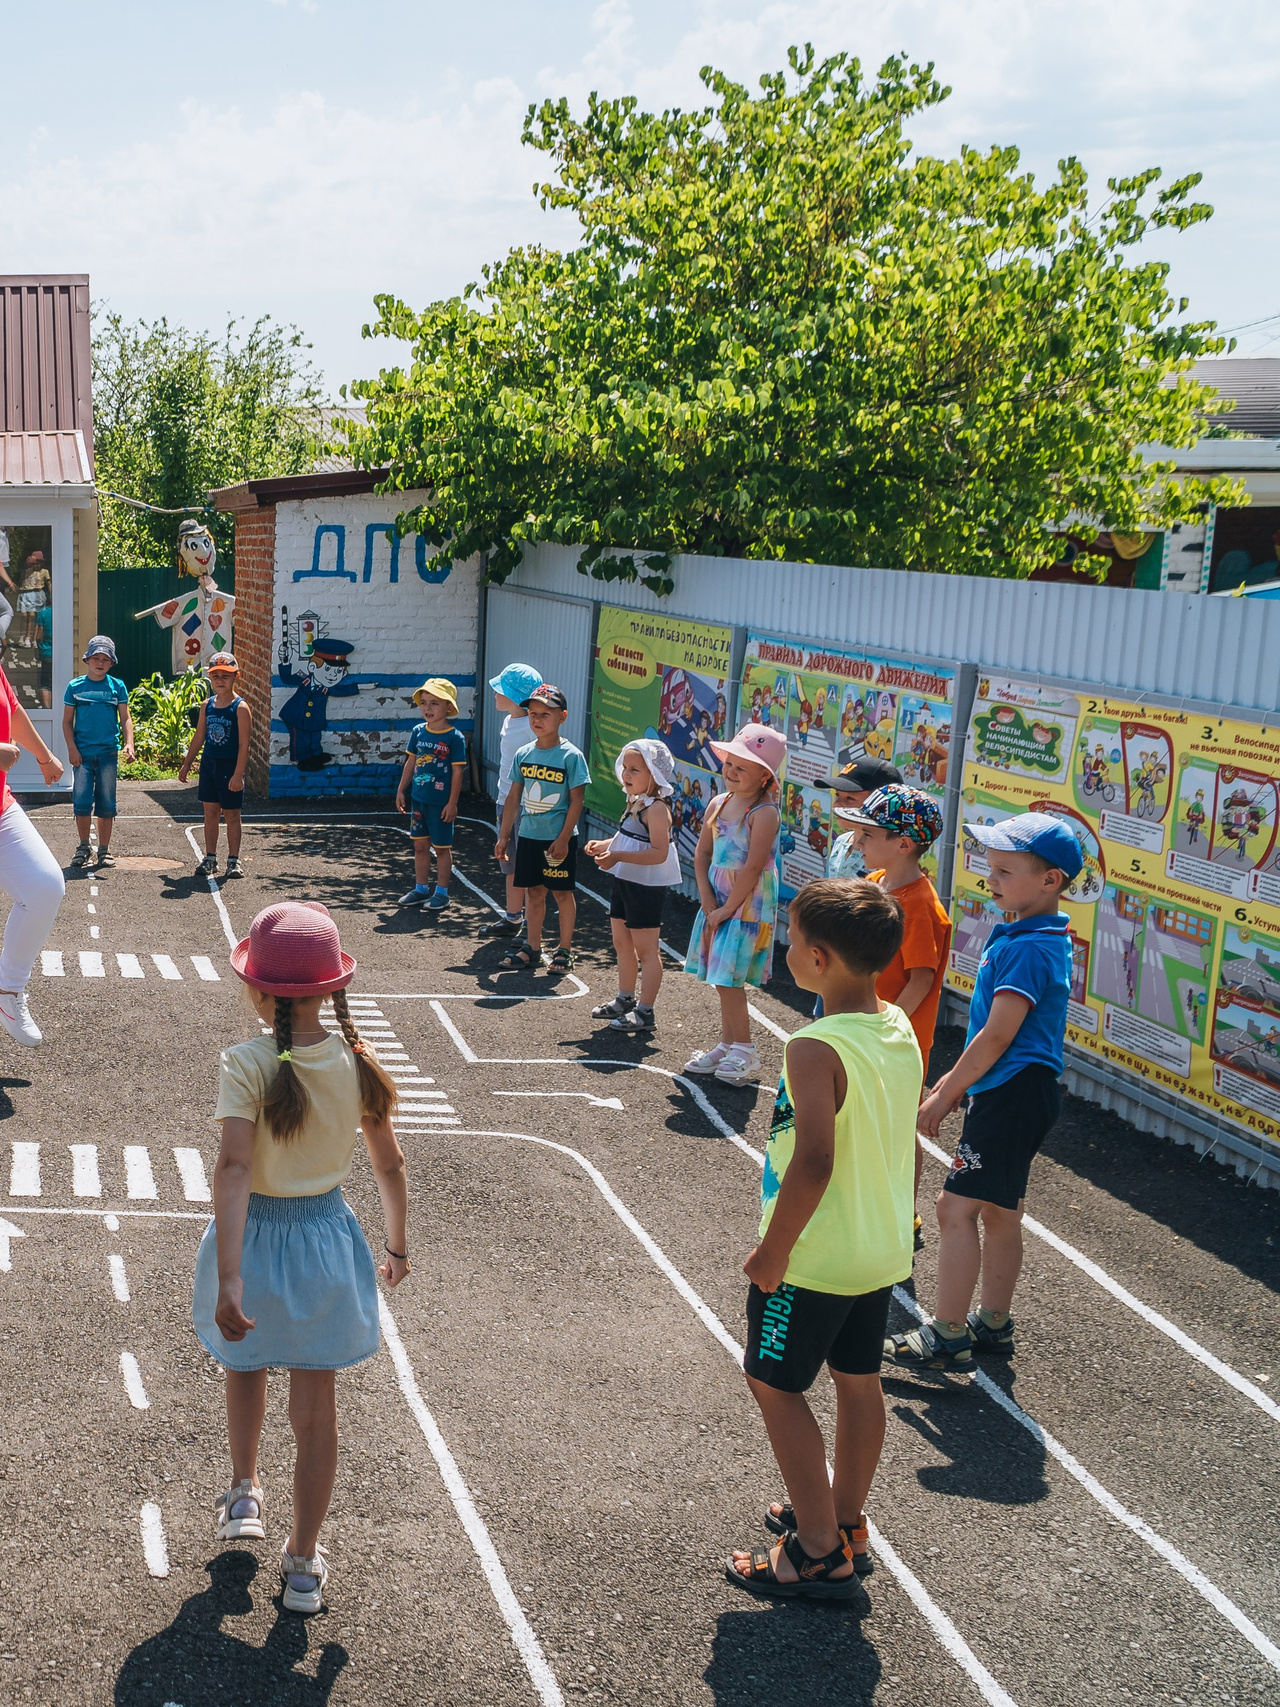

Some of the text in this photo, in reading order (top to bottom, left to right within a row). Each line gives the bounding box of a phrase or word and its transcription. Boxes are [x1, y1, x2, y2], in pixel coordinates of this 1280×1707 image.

[292, 522, 453, 584] ДПС
[684, 650, 729, 672] НА ДОРОГЕ
[757, 643, 948, 697] ПРАВИЛА ДОРОЖНОГО ДВИЖЕНИЯ
[1086, 700, 1102, 714] 2.
[1103, 706, 1120, 717] Твои
[1153, 713, 1162, 721] не
[986, 732, 1046, 752] НАЧИНАЮЩИМ
[1200, 726, 1219, 743] 3.
[984, 741, 1058, 764] ВЕЛОСИПЕДИСТАМ
[1189, 743, 1200, 751] не
[1237, 750, 1273, 763] повозка
[520, 764, 564, 783] adidas
[972, 773, 984, 787] 1.
[985, 780, 1008, 791] Дорога
[1013, 786, 1024, 794] это
[1032, 790, 1051, 799] цирк!
[542, 868, 569, 878] adidas
[1129, 859, 1147, 875] 5.
[1110, 868, 1156, 890] Расположение
[1157, 885, 1166, 893] на
[1166, 888, 1200, 905] проезжей
[1201, 899, 1222, 912] части
[1234, 907, 1253, 924] 6.
[1083, 1036, 1098, 1049] ты
[1102, 1045, 1150, 1074] можешь
[1155, 1070, 1221, 1108] выезжать
[1225, 1105, 1242, 1118] на
[759, 1281, 798, 1361] RIGINAL
